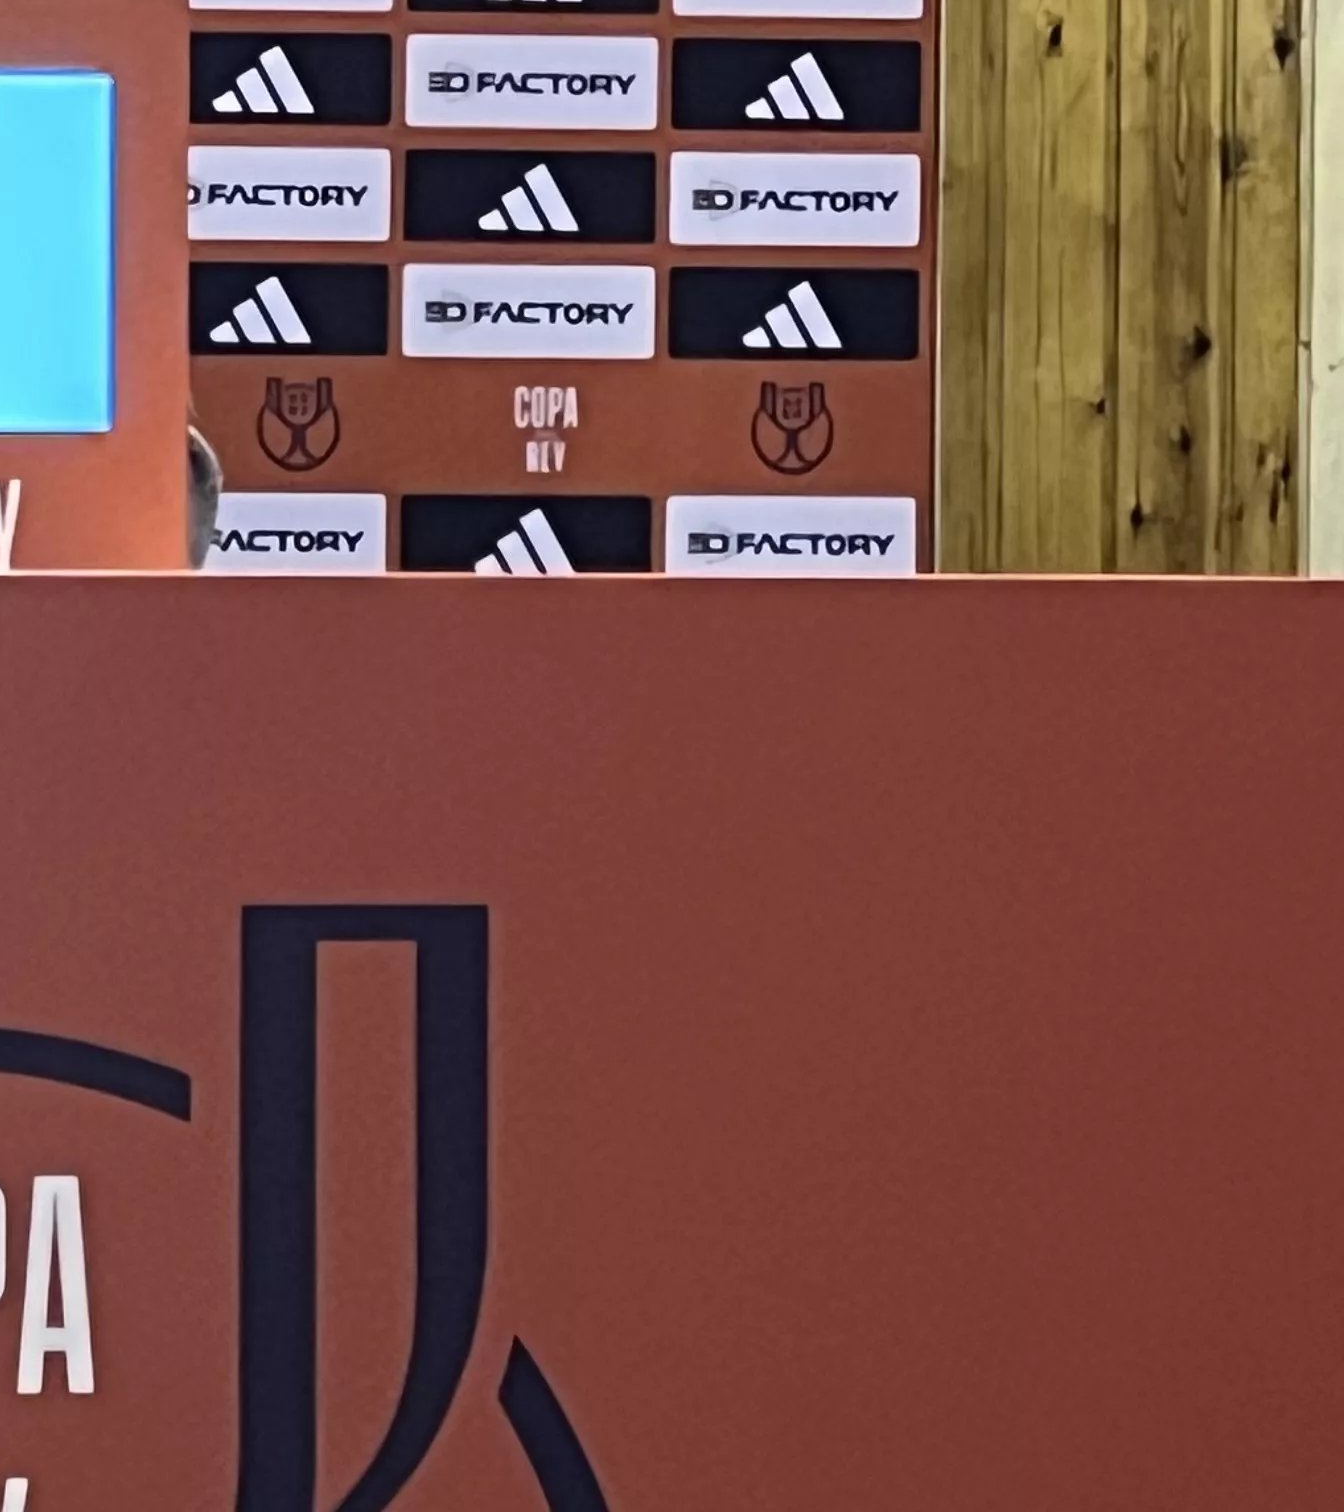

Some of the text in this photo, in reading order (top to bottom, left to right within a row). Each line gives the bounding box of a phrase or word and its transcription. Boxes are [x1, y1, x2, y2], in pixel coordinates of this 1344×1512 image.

[477, 72, 636, 95] FACTORY
[208, 184, 368, 206] FACTORY
[740, 190, 898, 213] FACTORY
[474, 302, 633, 325] FACTORY
[515, 387, 577, 427] COPA
[736, 533, 895, 556] FACTORY
